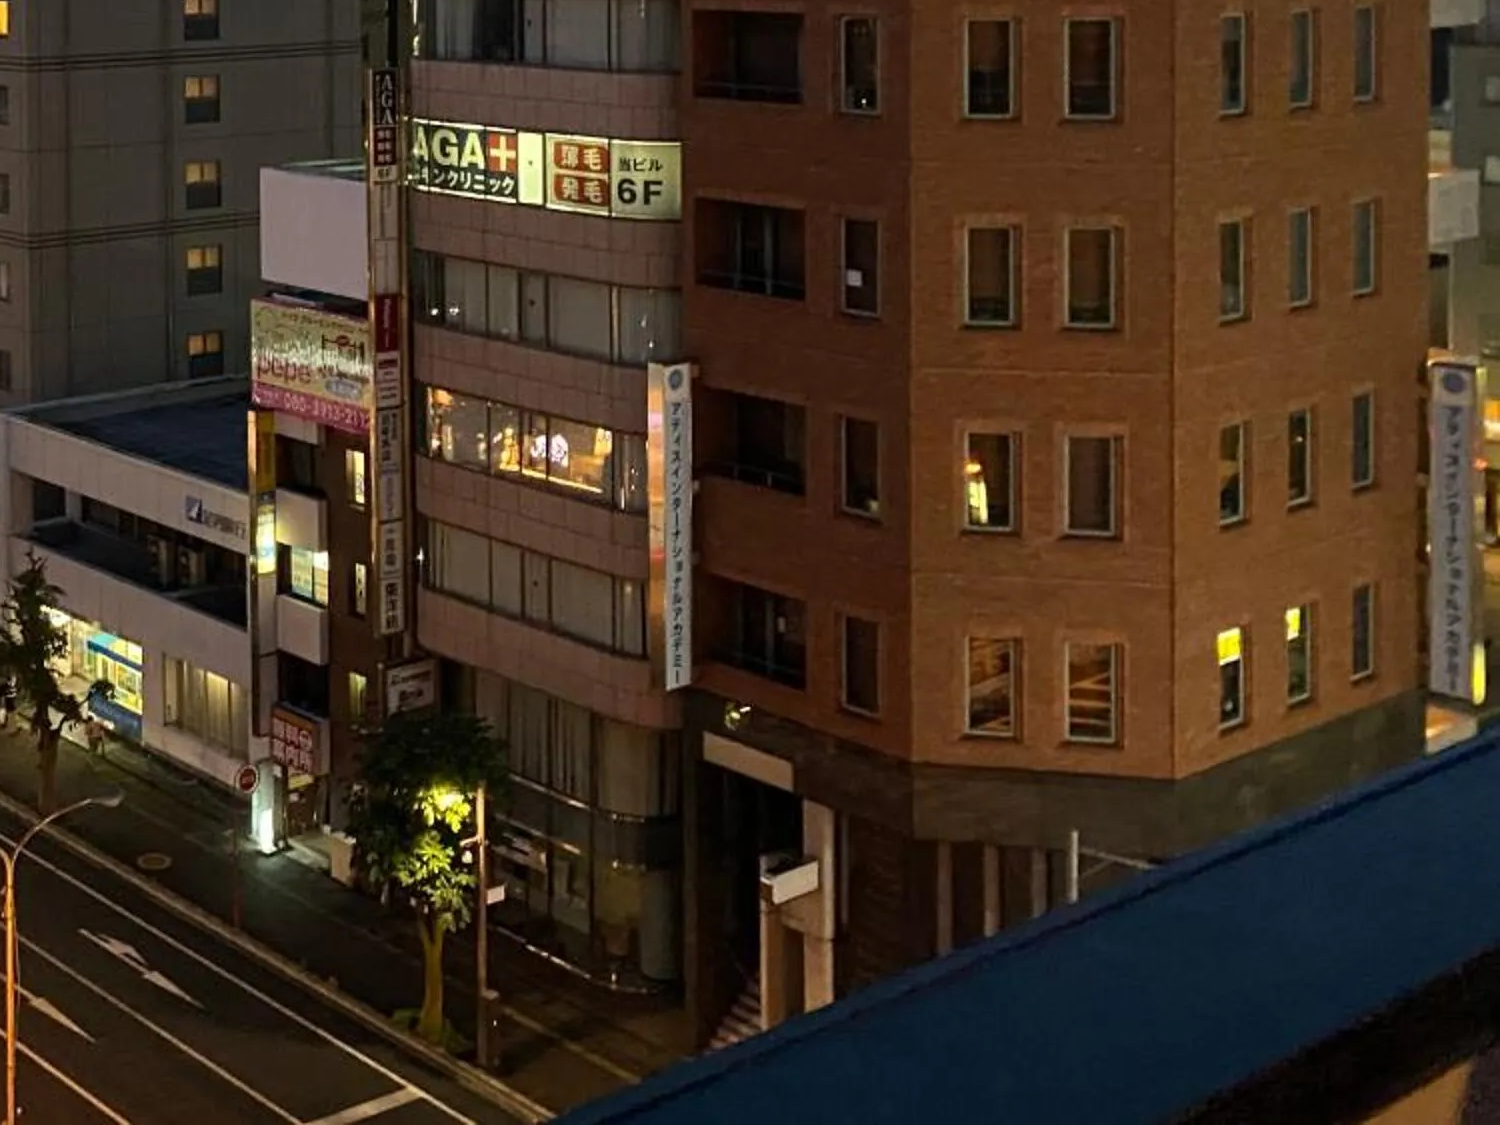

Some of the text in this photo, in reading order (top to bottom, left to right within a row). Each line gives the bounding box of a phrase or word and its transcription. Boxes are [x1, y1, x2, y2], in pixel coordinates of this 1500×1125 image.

[380, 75, 393, 124] AGA
[413, 126, 485, 170] AGA
[618, 157, 663, 173] 当ビル
[561, 176, 603, 204] 発毛
[617, 178, 663, 205] 6F
